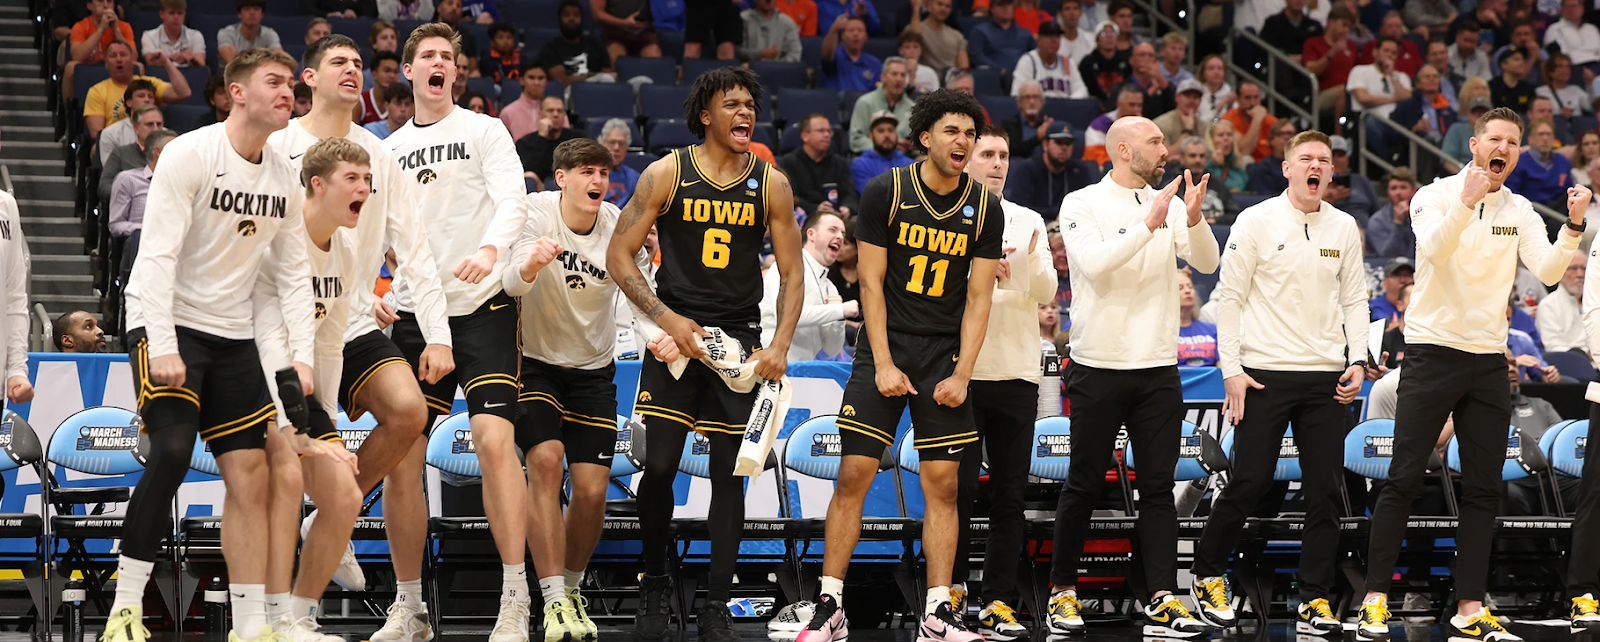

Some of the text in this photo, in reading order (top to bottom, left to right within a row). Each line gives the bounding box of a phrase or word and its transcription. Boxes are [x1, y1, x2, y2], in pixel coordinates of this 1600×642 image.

[430, 144, 445, 164] IT
[447, 142, 470, 160] IN.
[210, 187, 254, 215] LOCK
[683, 198, 755, 226] IOWA
[897, 221, 968, 256] IOWA
[1491, 226, 1518, 236] IOWA
[702, 228, 732, 269] 6
[1320, 249, 1340, 258] IOWA
[906, 255, 949, 297] 11
[90, 428, 122, 437] MARCH
[1047, 436, 1070, 445] MARC
[94, 437, 137, 447] MADNESS
[1180, 446, 1201, 455] NESS
